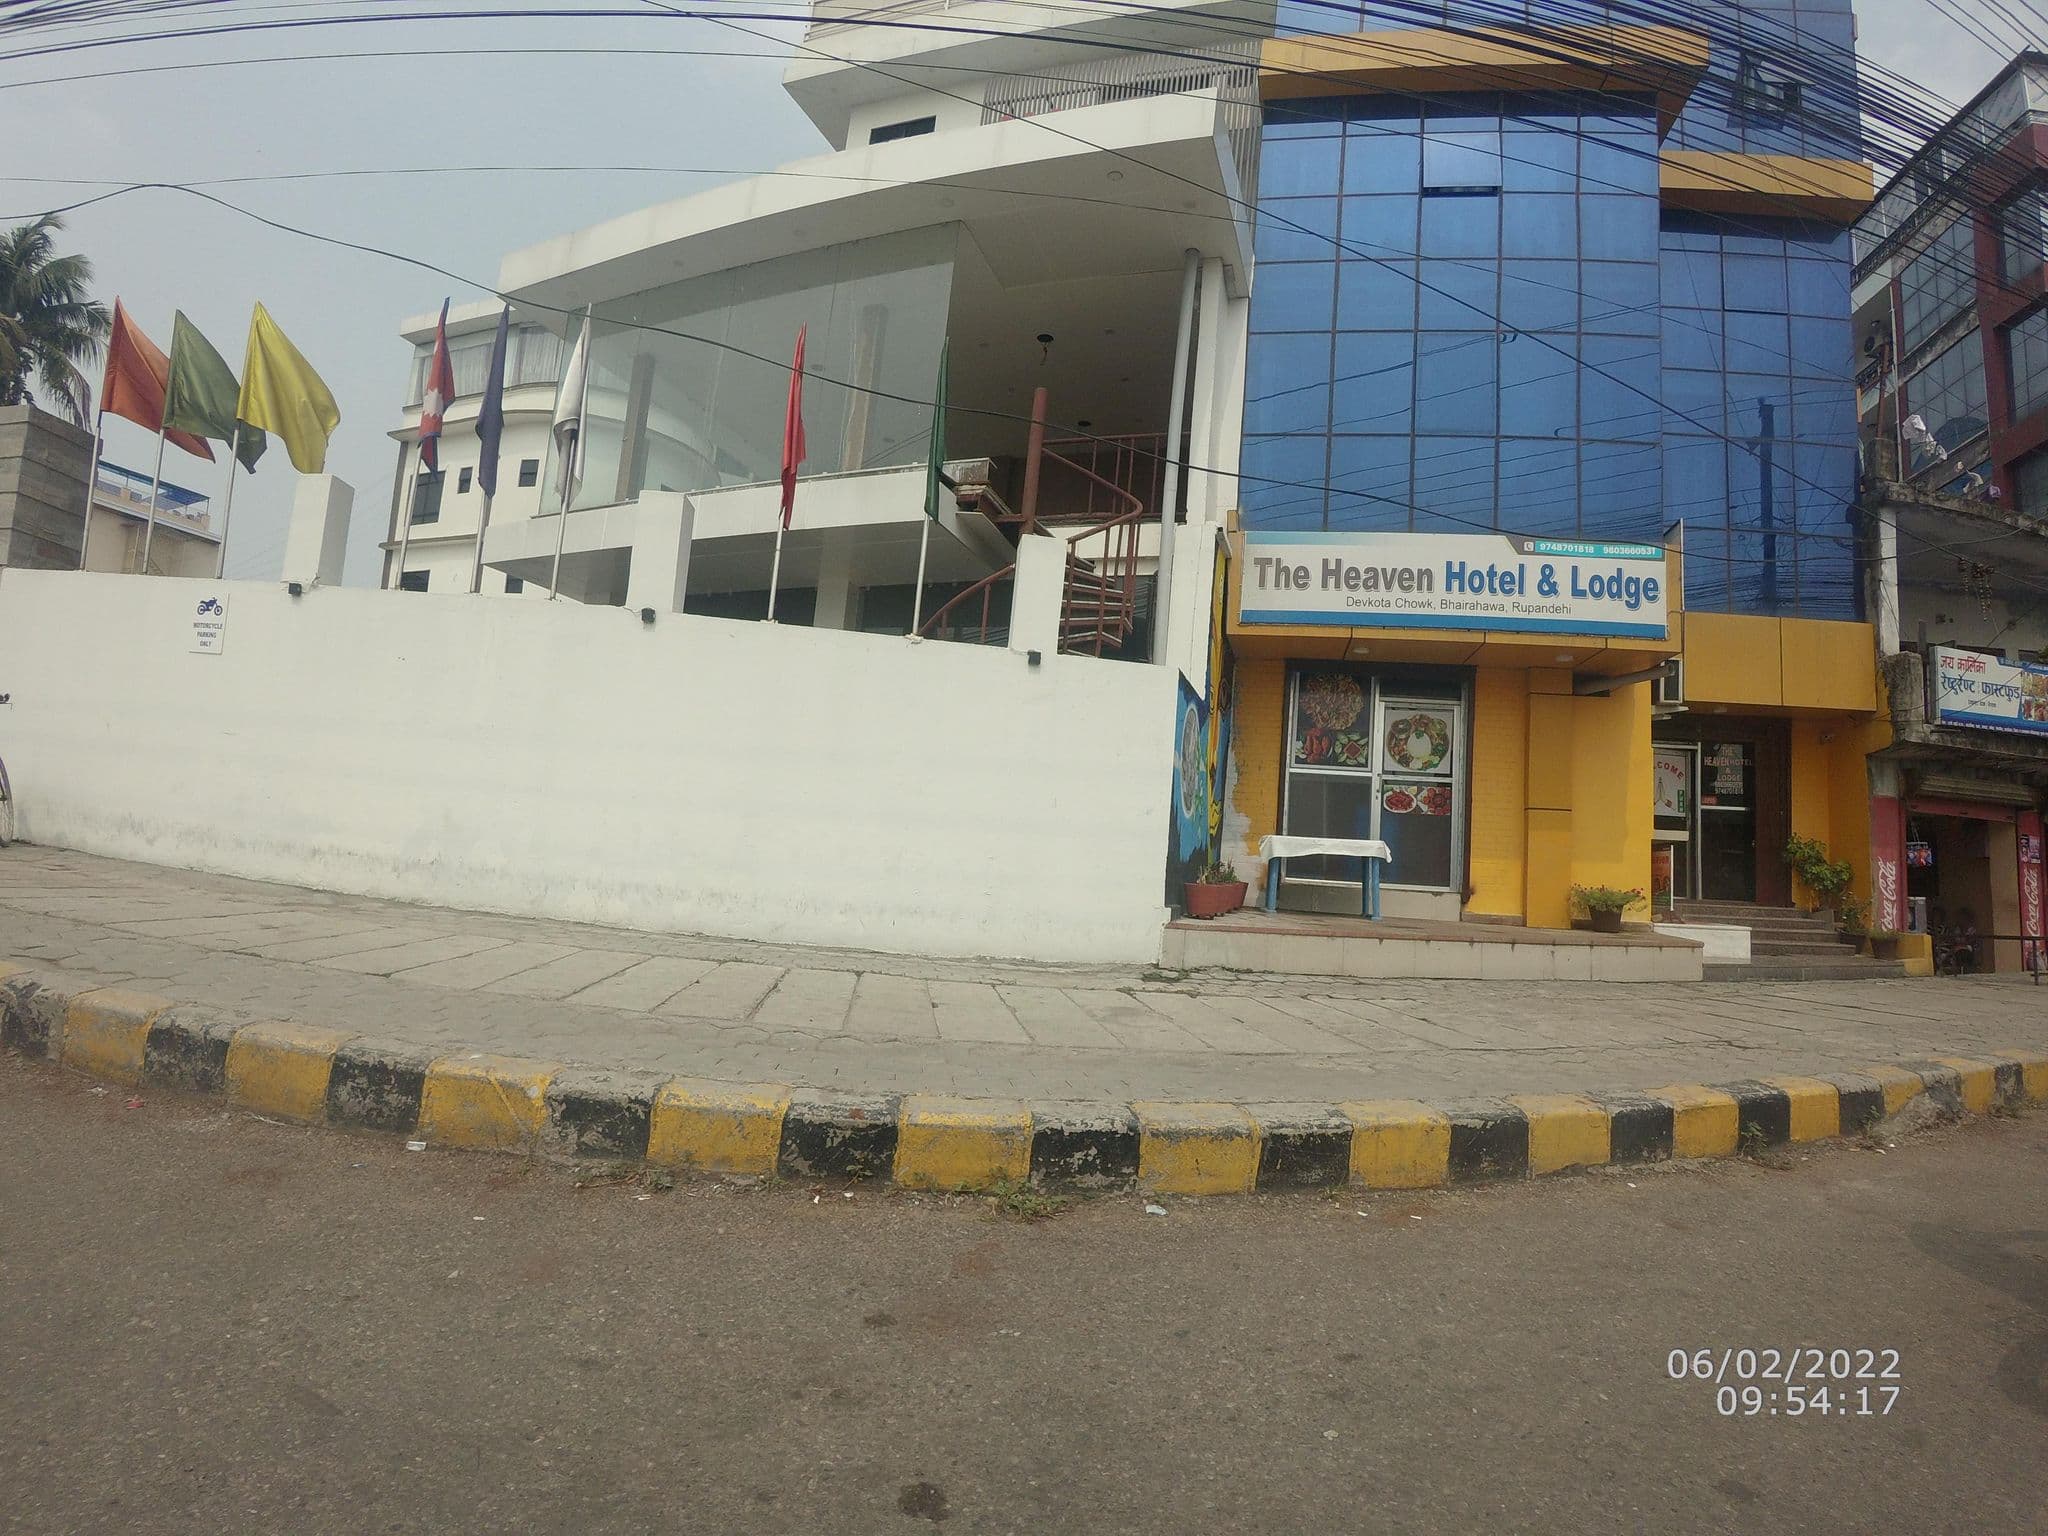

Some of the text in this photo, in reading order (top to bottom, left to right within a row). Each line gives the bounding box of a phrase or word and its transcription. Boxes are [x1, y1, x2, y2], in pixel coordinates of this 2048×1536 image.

[1254, 557, 1660, 611] The Heaven Hotel & Lodge
[1346, 596, 1572, 616] Devkota Chowk, Bhairahawa, Rupandehi
